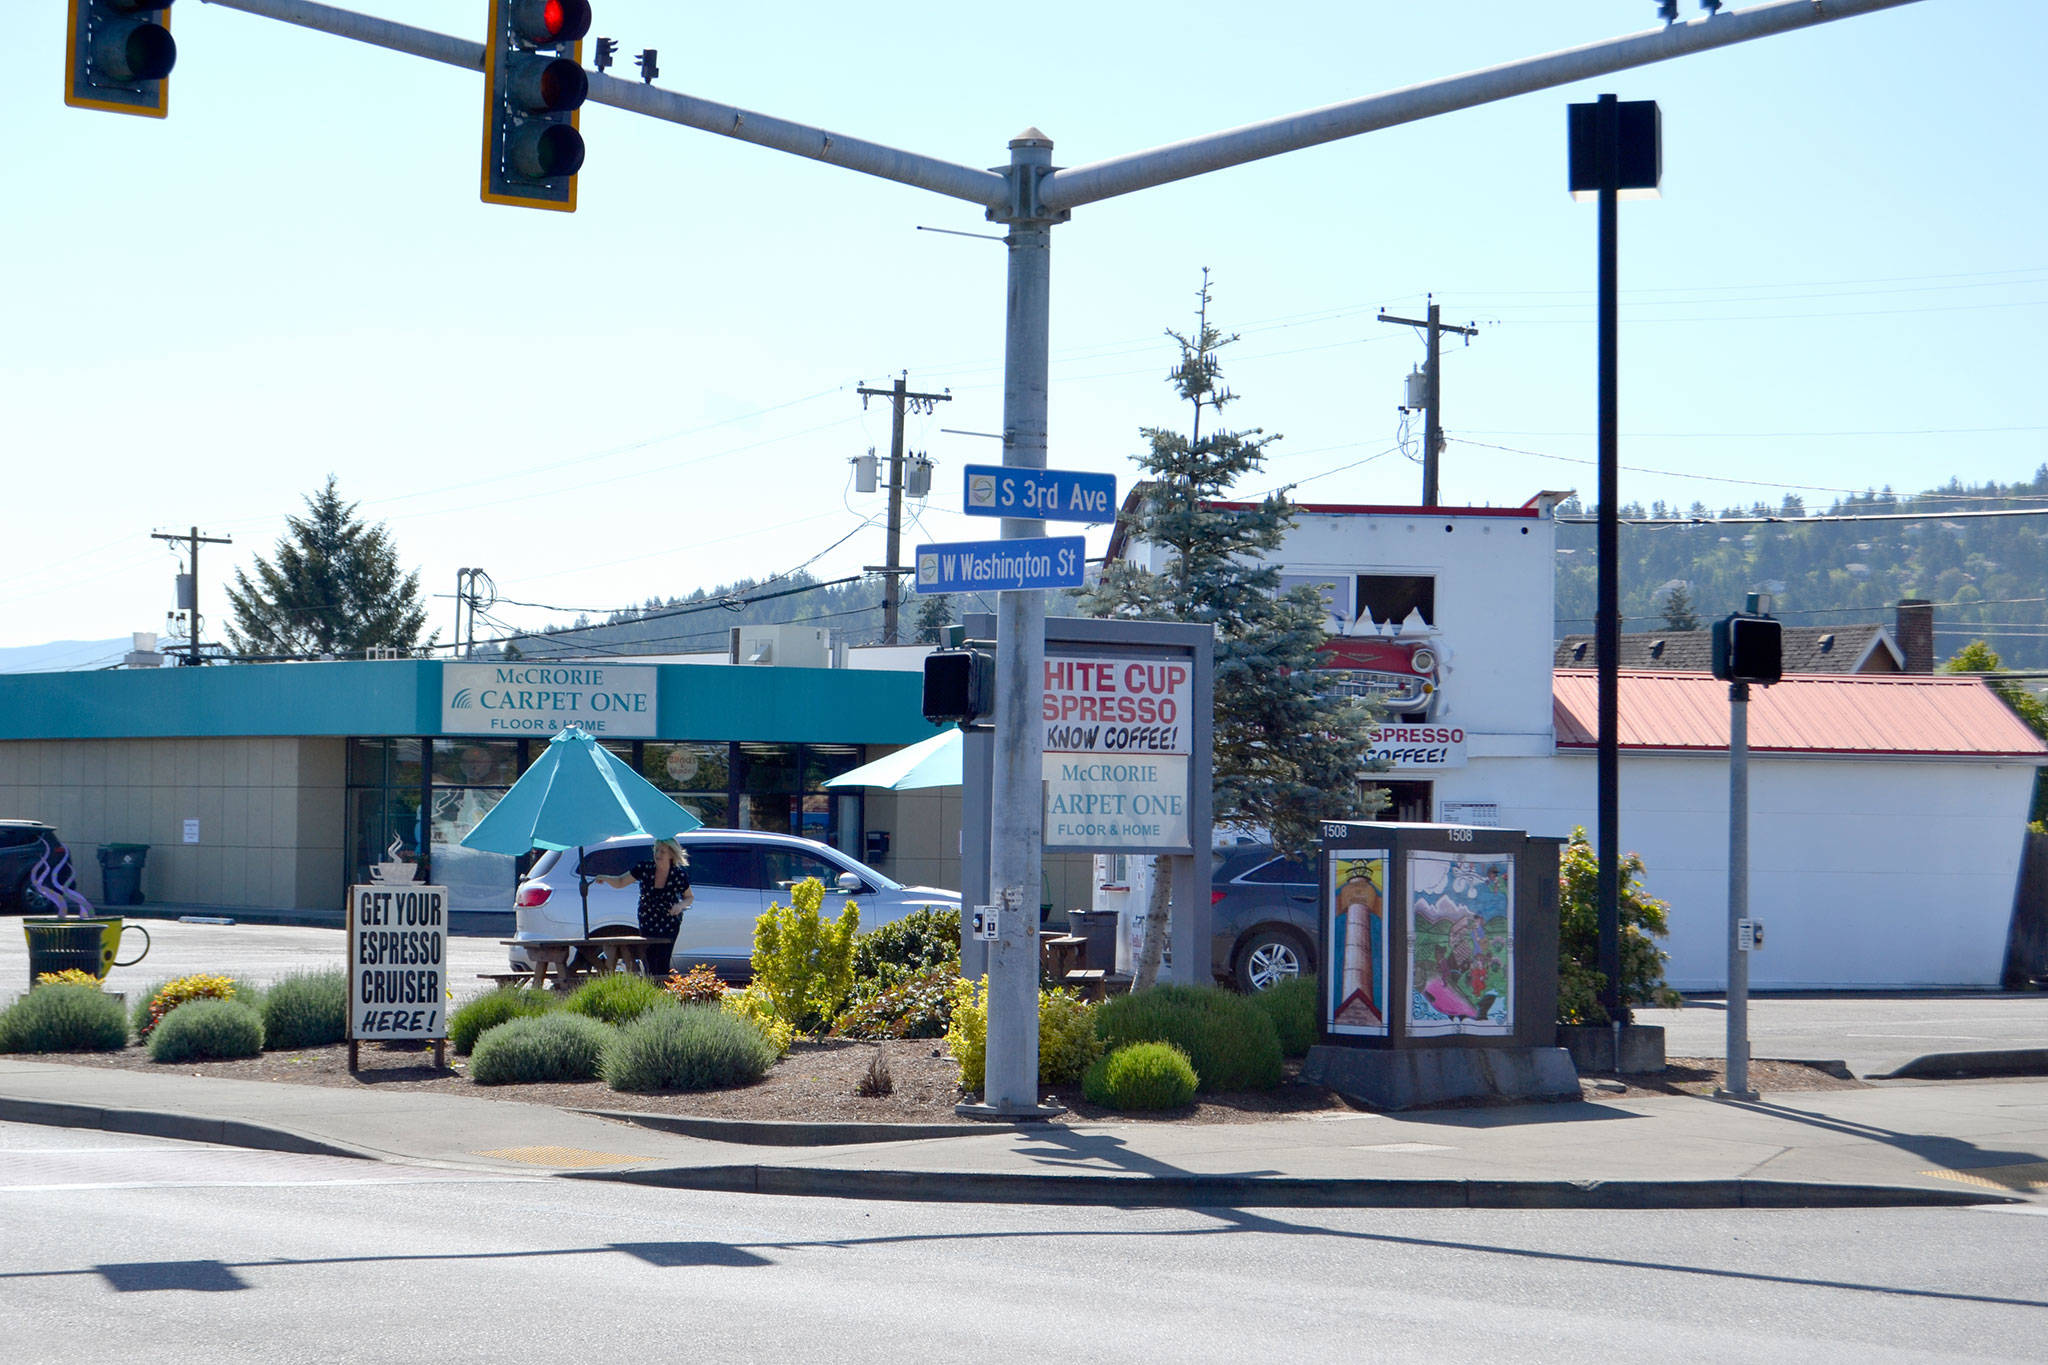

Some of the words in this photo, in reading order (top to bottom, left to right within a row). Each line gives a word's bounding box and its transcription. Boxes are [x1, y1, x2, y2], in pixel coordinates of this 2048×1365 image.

[1001, 478, 1015, 507] S
[1023, 480, 1058, 510] 3rd
[1069, 483, 1107, 513] Ave
[942, 553, 956, 582] W
[960, 551, 1051, 587] Washington
[1057, 548, 1076, 577] St
[496, 668, 604, 686] McCRORIE
[1044, 661, 1116, 692] HITE
[1125, 664, 1186, 694] CUP
[480, 690, 582, 711] CARPET
[591, 692, 647, 712] ONE
[1043, 694, 1177, 724] SPRESSO
[491, 718, 544, 730] FLOOR
[548, 719, 558, 730] &
[1047, 725, 1100, 750] KNOW
[1104, 726, 1178, 750] COFFEE!
[1369, 728, 1464, 744] SPRESSO
[1364, 748, 1448, 763] COFFEE!
[1062, 764, 1158, 783] McCRORIE
[1050, 794, 1128, 815] ARPET
[1132, 795, 1182, 816] ONE
[1058, 823, 1106, 836] FLOOR
[1110, 824, 1118, 836] &
[1122, 824, 1160, 836] HOME
[1322, 825, 1347, 838] 1508
[1448, 829, 1473, 842] 1508
[361, 892, 391, 926] GET
[395, 892, 441, 926] YOUR
[359, 931, 441, 965] ESPRESSO
[361, 969, 438, 1004] CRUISER
[361, 1010, 437, 1033] HERE!
